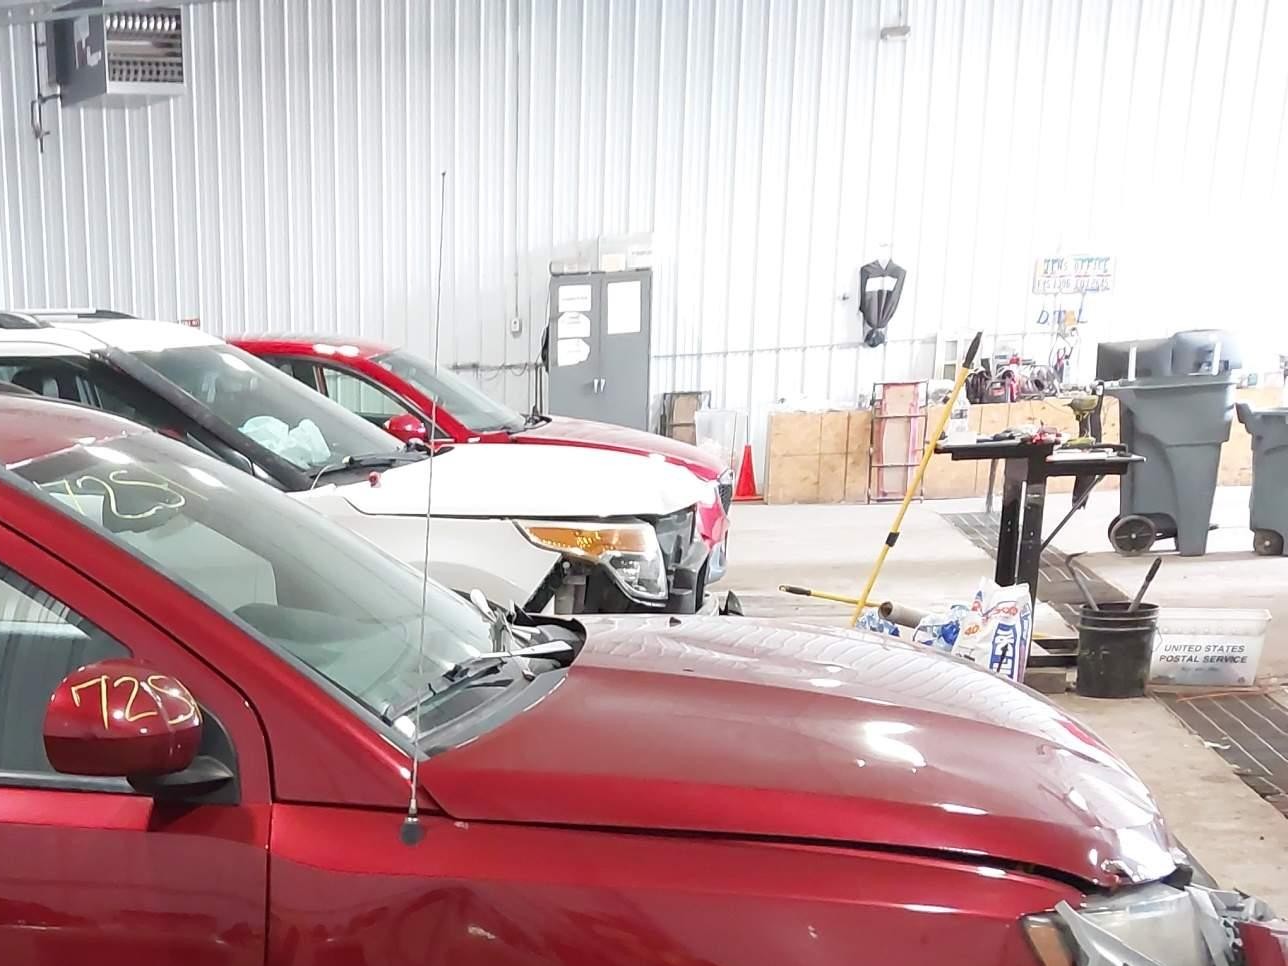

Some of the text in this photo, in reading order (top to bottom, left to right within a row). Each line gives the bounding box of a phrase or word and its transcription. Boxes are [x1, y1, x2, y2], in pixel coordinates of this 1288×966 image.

[1164, 644, 1245, 653] UNITED STATES
[1160, 654, 1248, 664] POSTAL SERVICE
